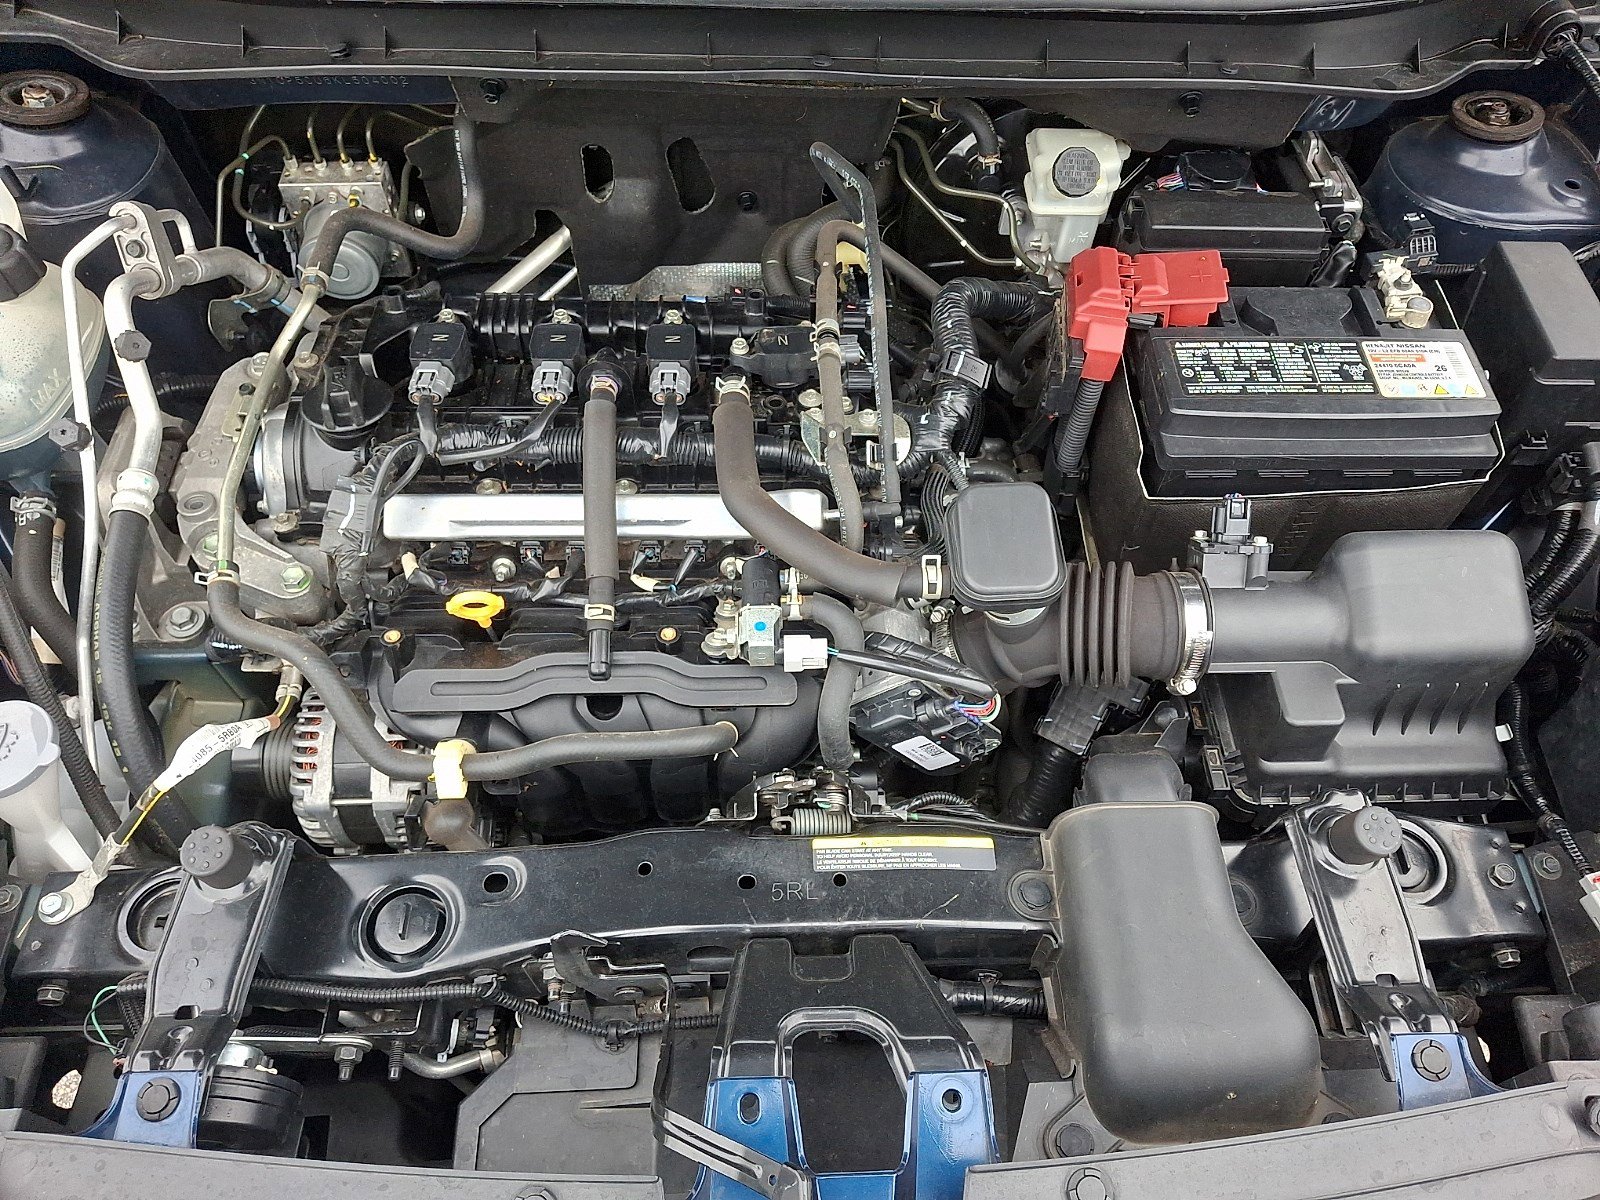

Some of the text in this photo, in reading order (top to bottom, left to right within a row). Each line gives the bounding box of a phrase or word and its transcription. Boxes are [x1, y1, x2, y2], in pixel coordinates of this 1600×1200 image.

[777, 335, 789, 346] N
[1434, 364, 1448, 372] 26
[771, 881, 819, 901] 5RL
